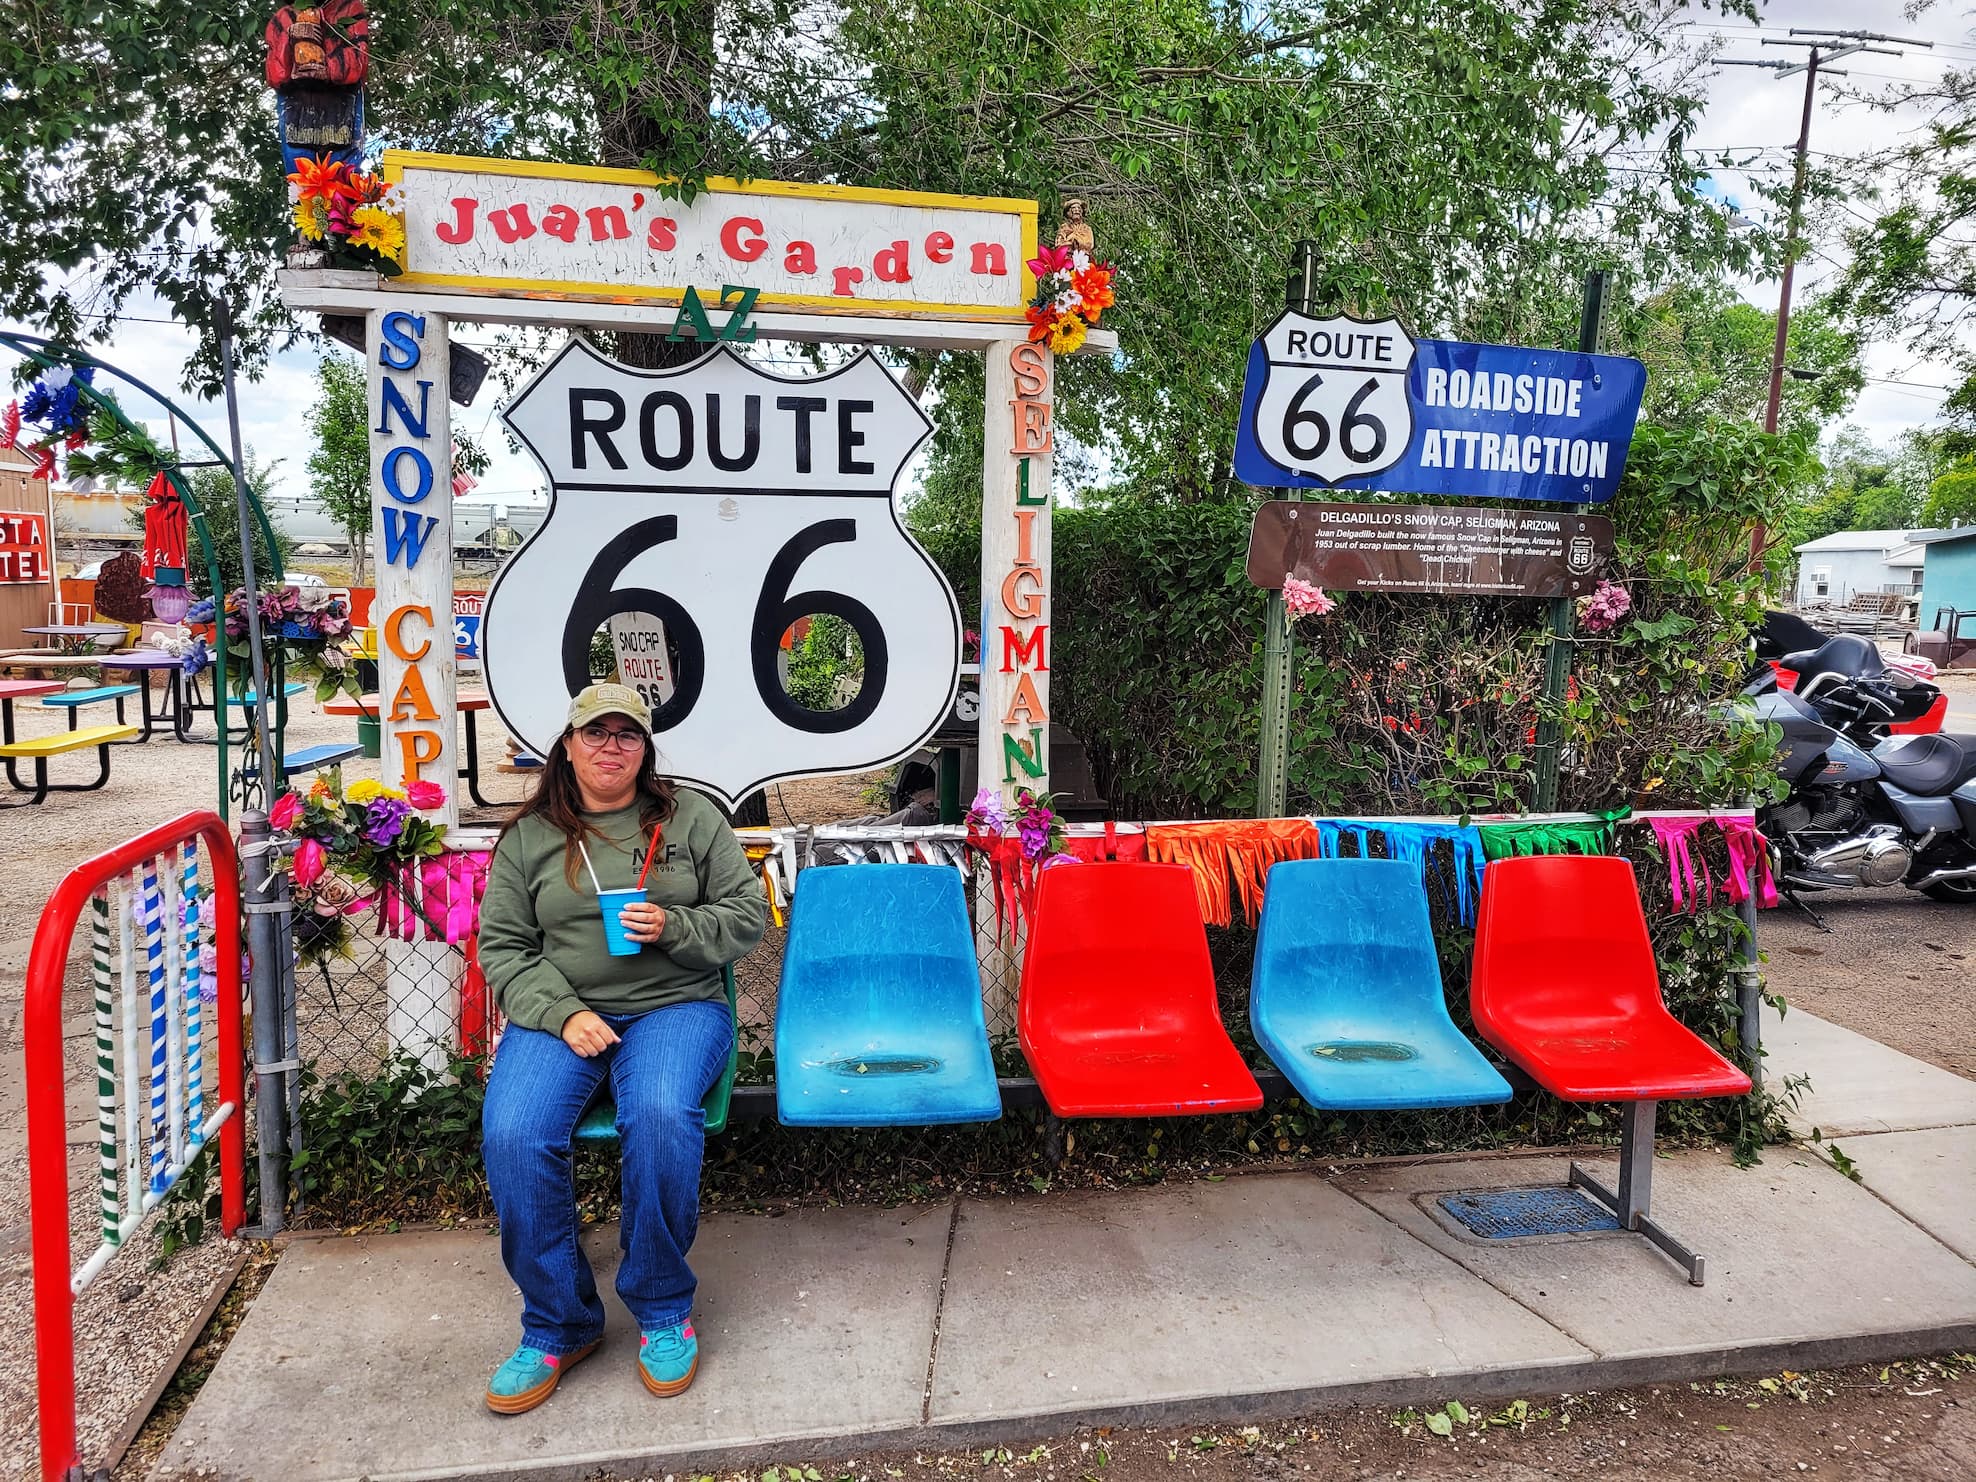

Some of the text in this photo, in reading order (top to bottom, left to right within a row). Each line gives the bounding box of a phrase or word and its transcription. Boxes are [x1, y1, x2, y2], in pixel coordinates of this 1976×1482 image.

[436, 193, 1009, 296] Juan's Garden
[665, 284, 762, 344] AZ
[1287, 329, 1393, 363] ROUTE
[1426, 367, 1583, 418] ROADSIDE
[568, 386, 875, 476] ROUTE
[1282, 373, 1388, 464] 66
[1420, 428, 1609, 479] ATTRACTION
[1315, 529, 1335, 538] Juan
[1336, 529, 1376, 540] Delgadillo
[1377, 530, 1395, 539] built
[1396, 531, 1409, 540] the
[1428, 531, 1455, 541] famous
[1457, 533, 1478, 542] Snow
[1478, 534, 1492, 544] Cap
[1493, 535, 1500, 543] in
[1500, 535, 1531, 546] Seligman,
[1532, 536, 1556, 546] Arizona
[1556, 538, 1563, 546] in
[1320, 511, 1561, 532] DELGADILLO'S SNOW CAP, SELIGMAN, ARIZONA
[374, 311, 443, 787] SNOW CAP
[998, 342, 1053, 784] SELIGMAN
[1315, 540, 1333, 549] 1953
[1349, 541, 1358, 549] of
[1359, 542, 1381, 551] scrap
[1382, 542, 1412, 551] lumber.
[1413, 543, 1436, 552] Home
[1437, 544, 1446, 552] of
[1446, 544, 1458, 553] the
[1510, 546, 1525, 555] with
[1550, 549, 1563, 557] and
[1573, 553, 1588, 565] 66
[562, 514, 888, 734] 66
[624, 658, 665, 681] ROUTE
